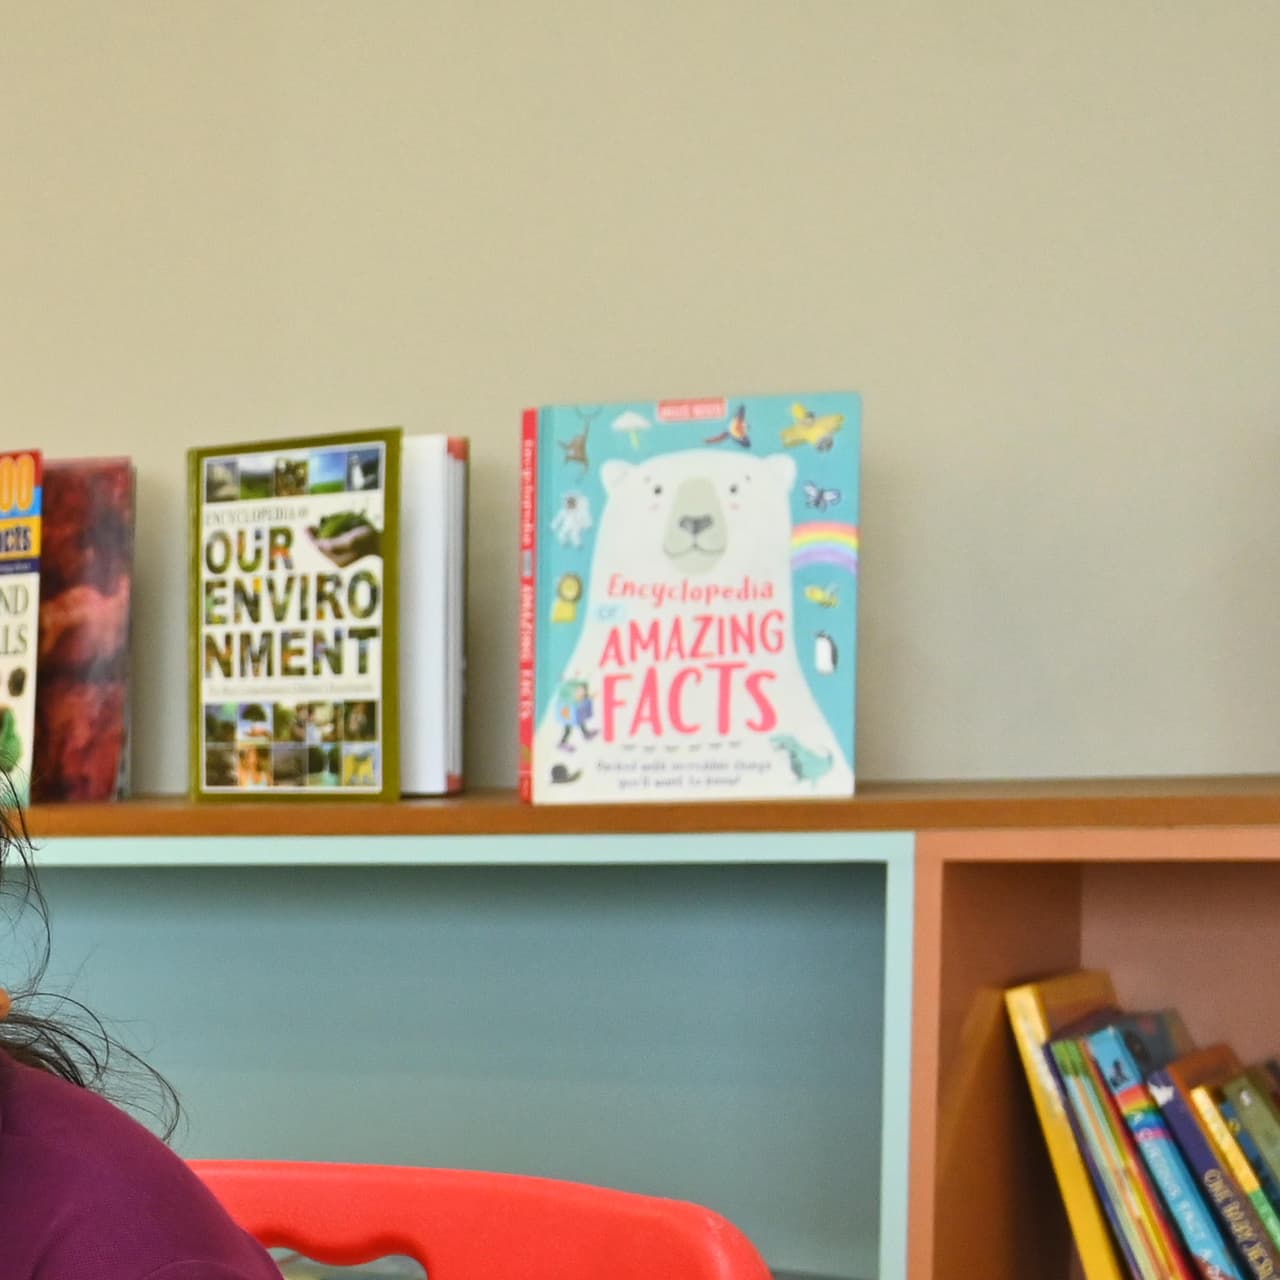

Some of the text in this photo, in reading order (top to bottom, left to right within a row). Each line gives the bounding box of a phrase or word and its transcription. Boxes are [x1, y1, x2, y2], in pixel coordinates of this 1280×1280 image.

[205, 527, 294, 575] OUR
[205, 570, 379, 626] ENVIRO
[608, 573, 774, 606] Encyclopedia
[205, 628, 378, 679] NMENT
[599, 611, 786, 668] AMAZING
[602, 662, 779, 743] FACTS
